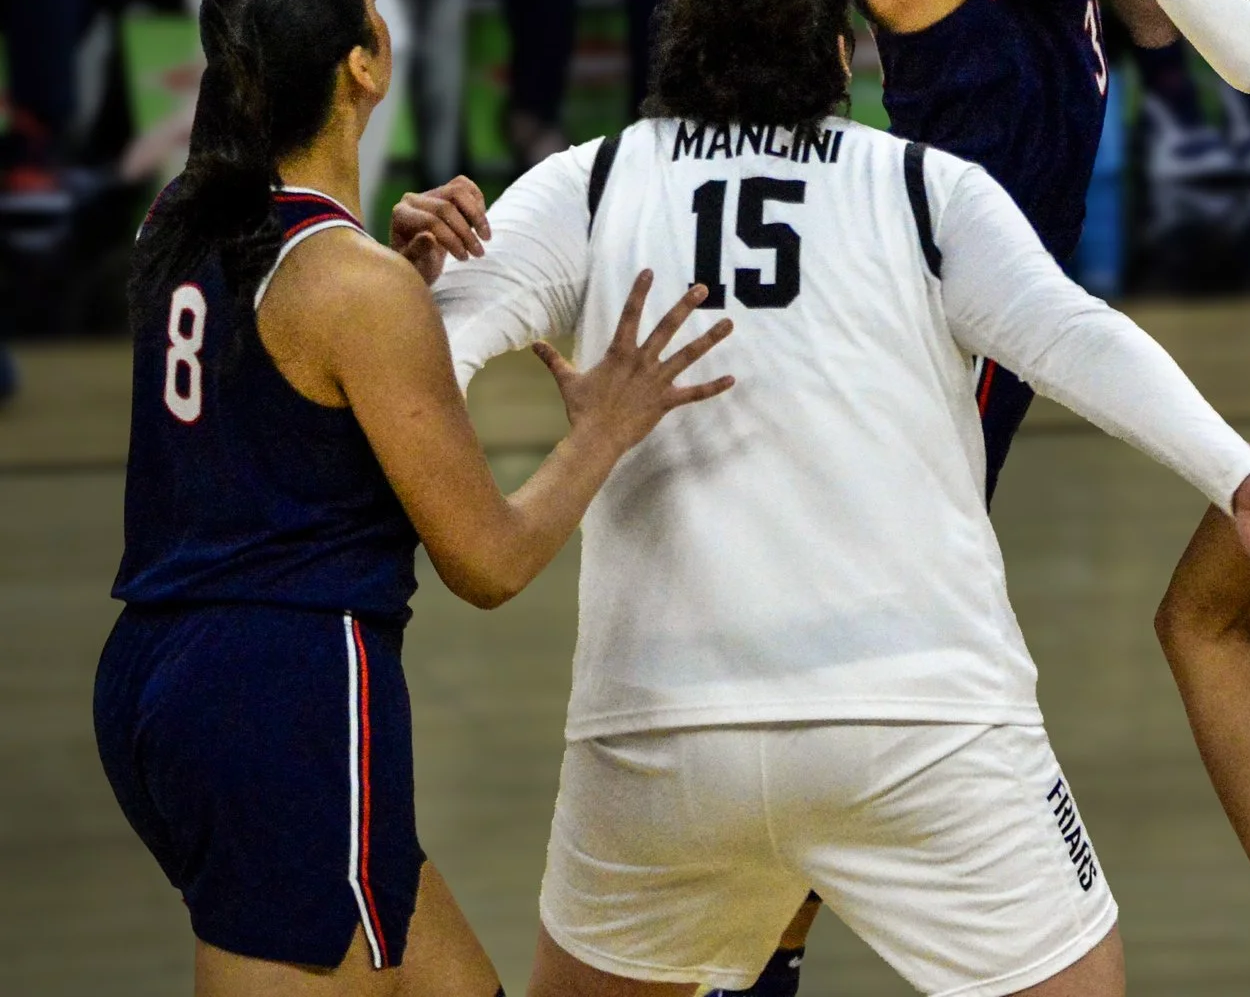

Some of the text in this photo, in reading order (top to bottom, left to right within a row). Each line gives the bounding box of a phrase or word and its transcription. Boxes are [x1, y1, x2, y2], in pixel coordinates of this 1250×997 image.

[672, 120, 845, 164] MANCINI
[687, 176, 807, 310] 15
[164, 280, 208, 426] 8
[1046, 778, 1098, 892] FRIARS
